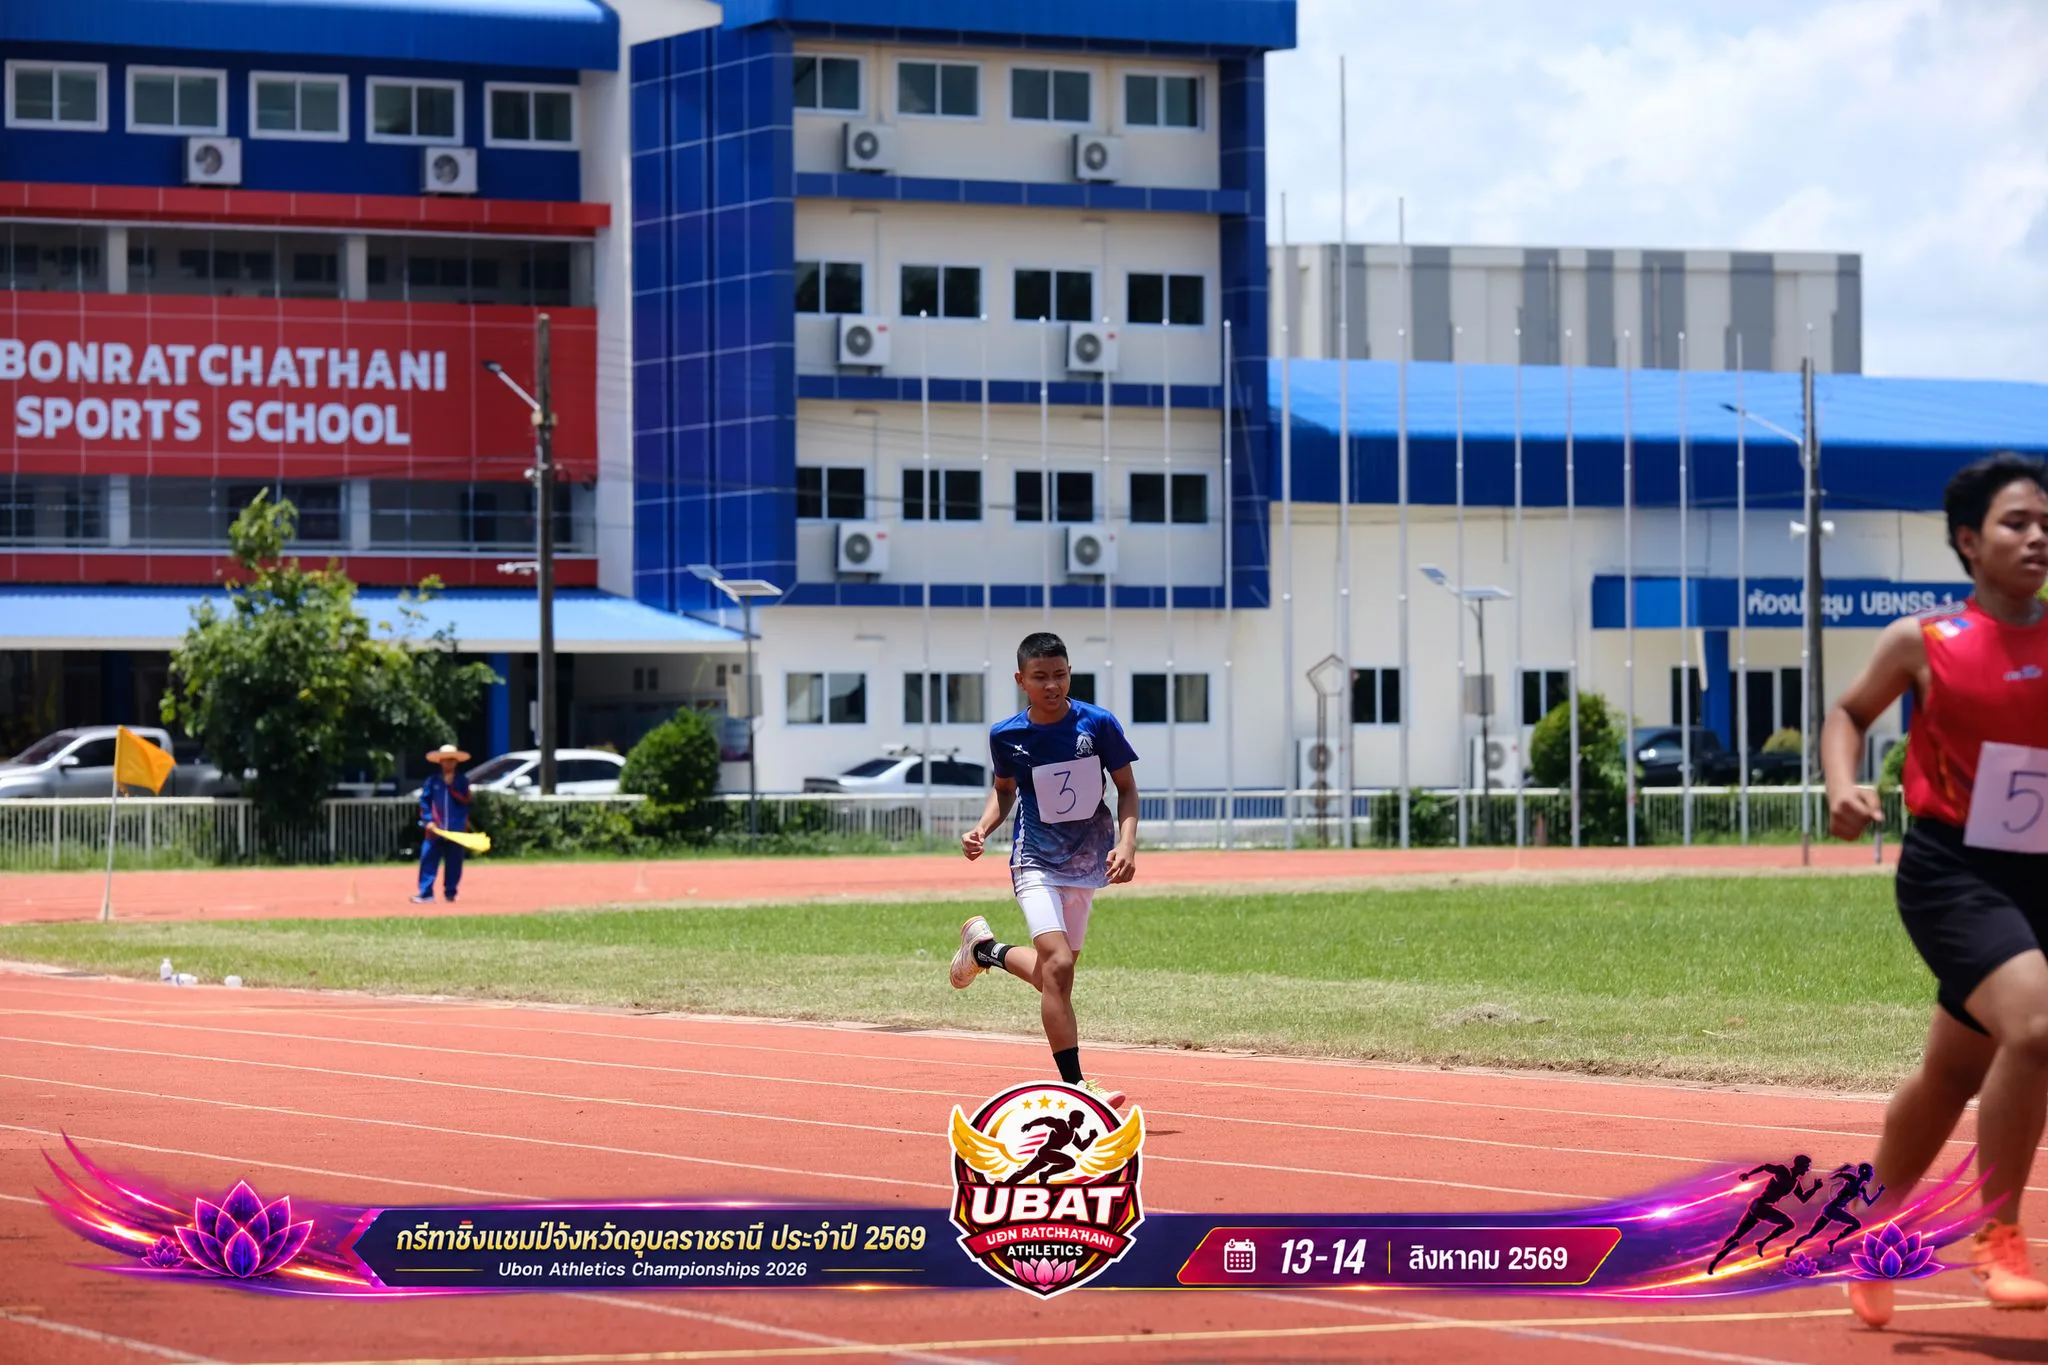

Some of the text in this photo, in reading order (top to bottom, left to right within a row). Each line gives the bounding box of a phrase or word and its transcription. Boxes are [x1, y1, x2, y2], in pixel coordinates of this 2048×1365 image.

[15, 396, 411, 446] SPORTS SCHOOL
[1053, 770, 1077, 815] 3
[2001, 770, 2048, 834] 5
